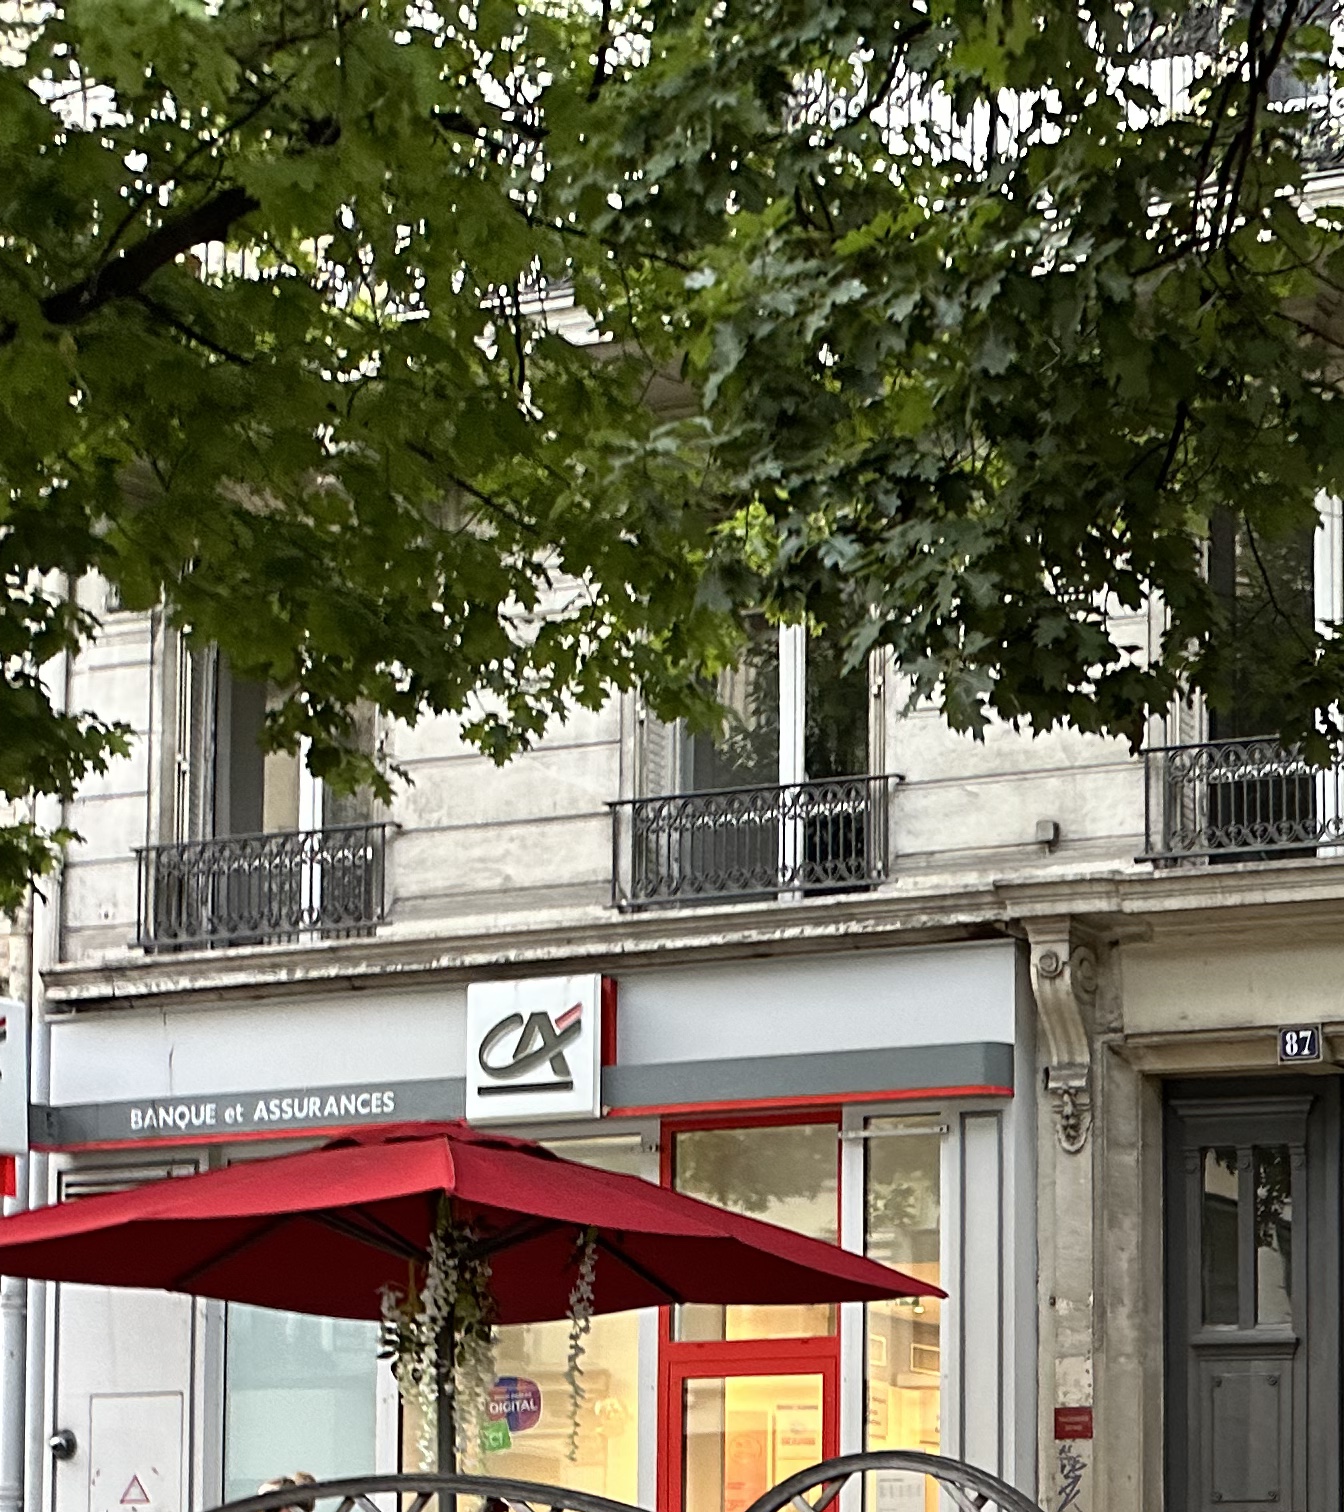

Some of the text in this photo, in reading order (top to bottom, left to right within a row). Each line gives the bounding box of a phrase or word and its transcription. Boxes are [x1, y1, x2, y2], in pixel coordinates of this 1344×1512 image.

[1285, 1030, 1312, 1057] 87
[130, 1091, 396, 1131] BANQUE et ASSURANCES
[489, 1398, 538, 1415] DIGITAL
